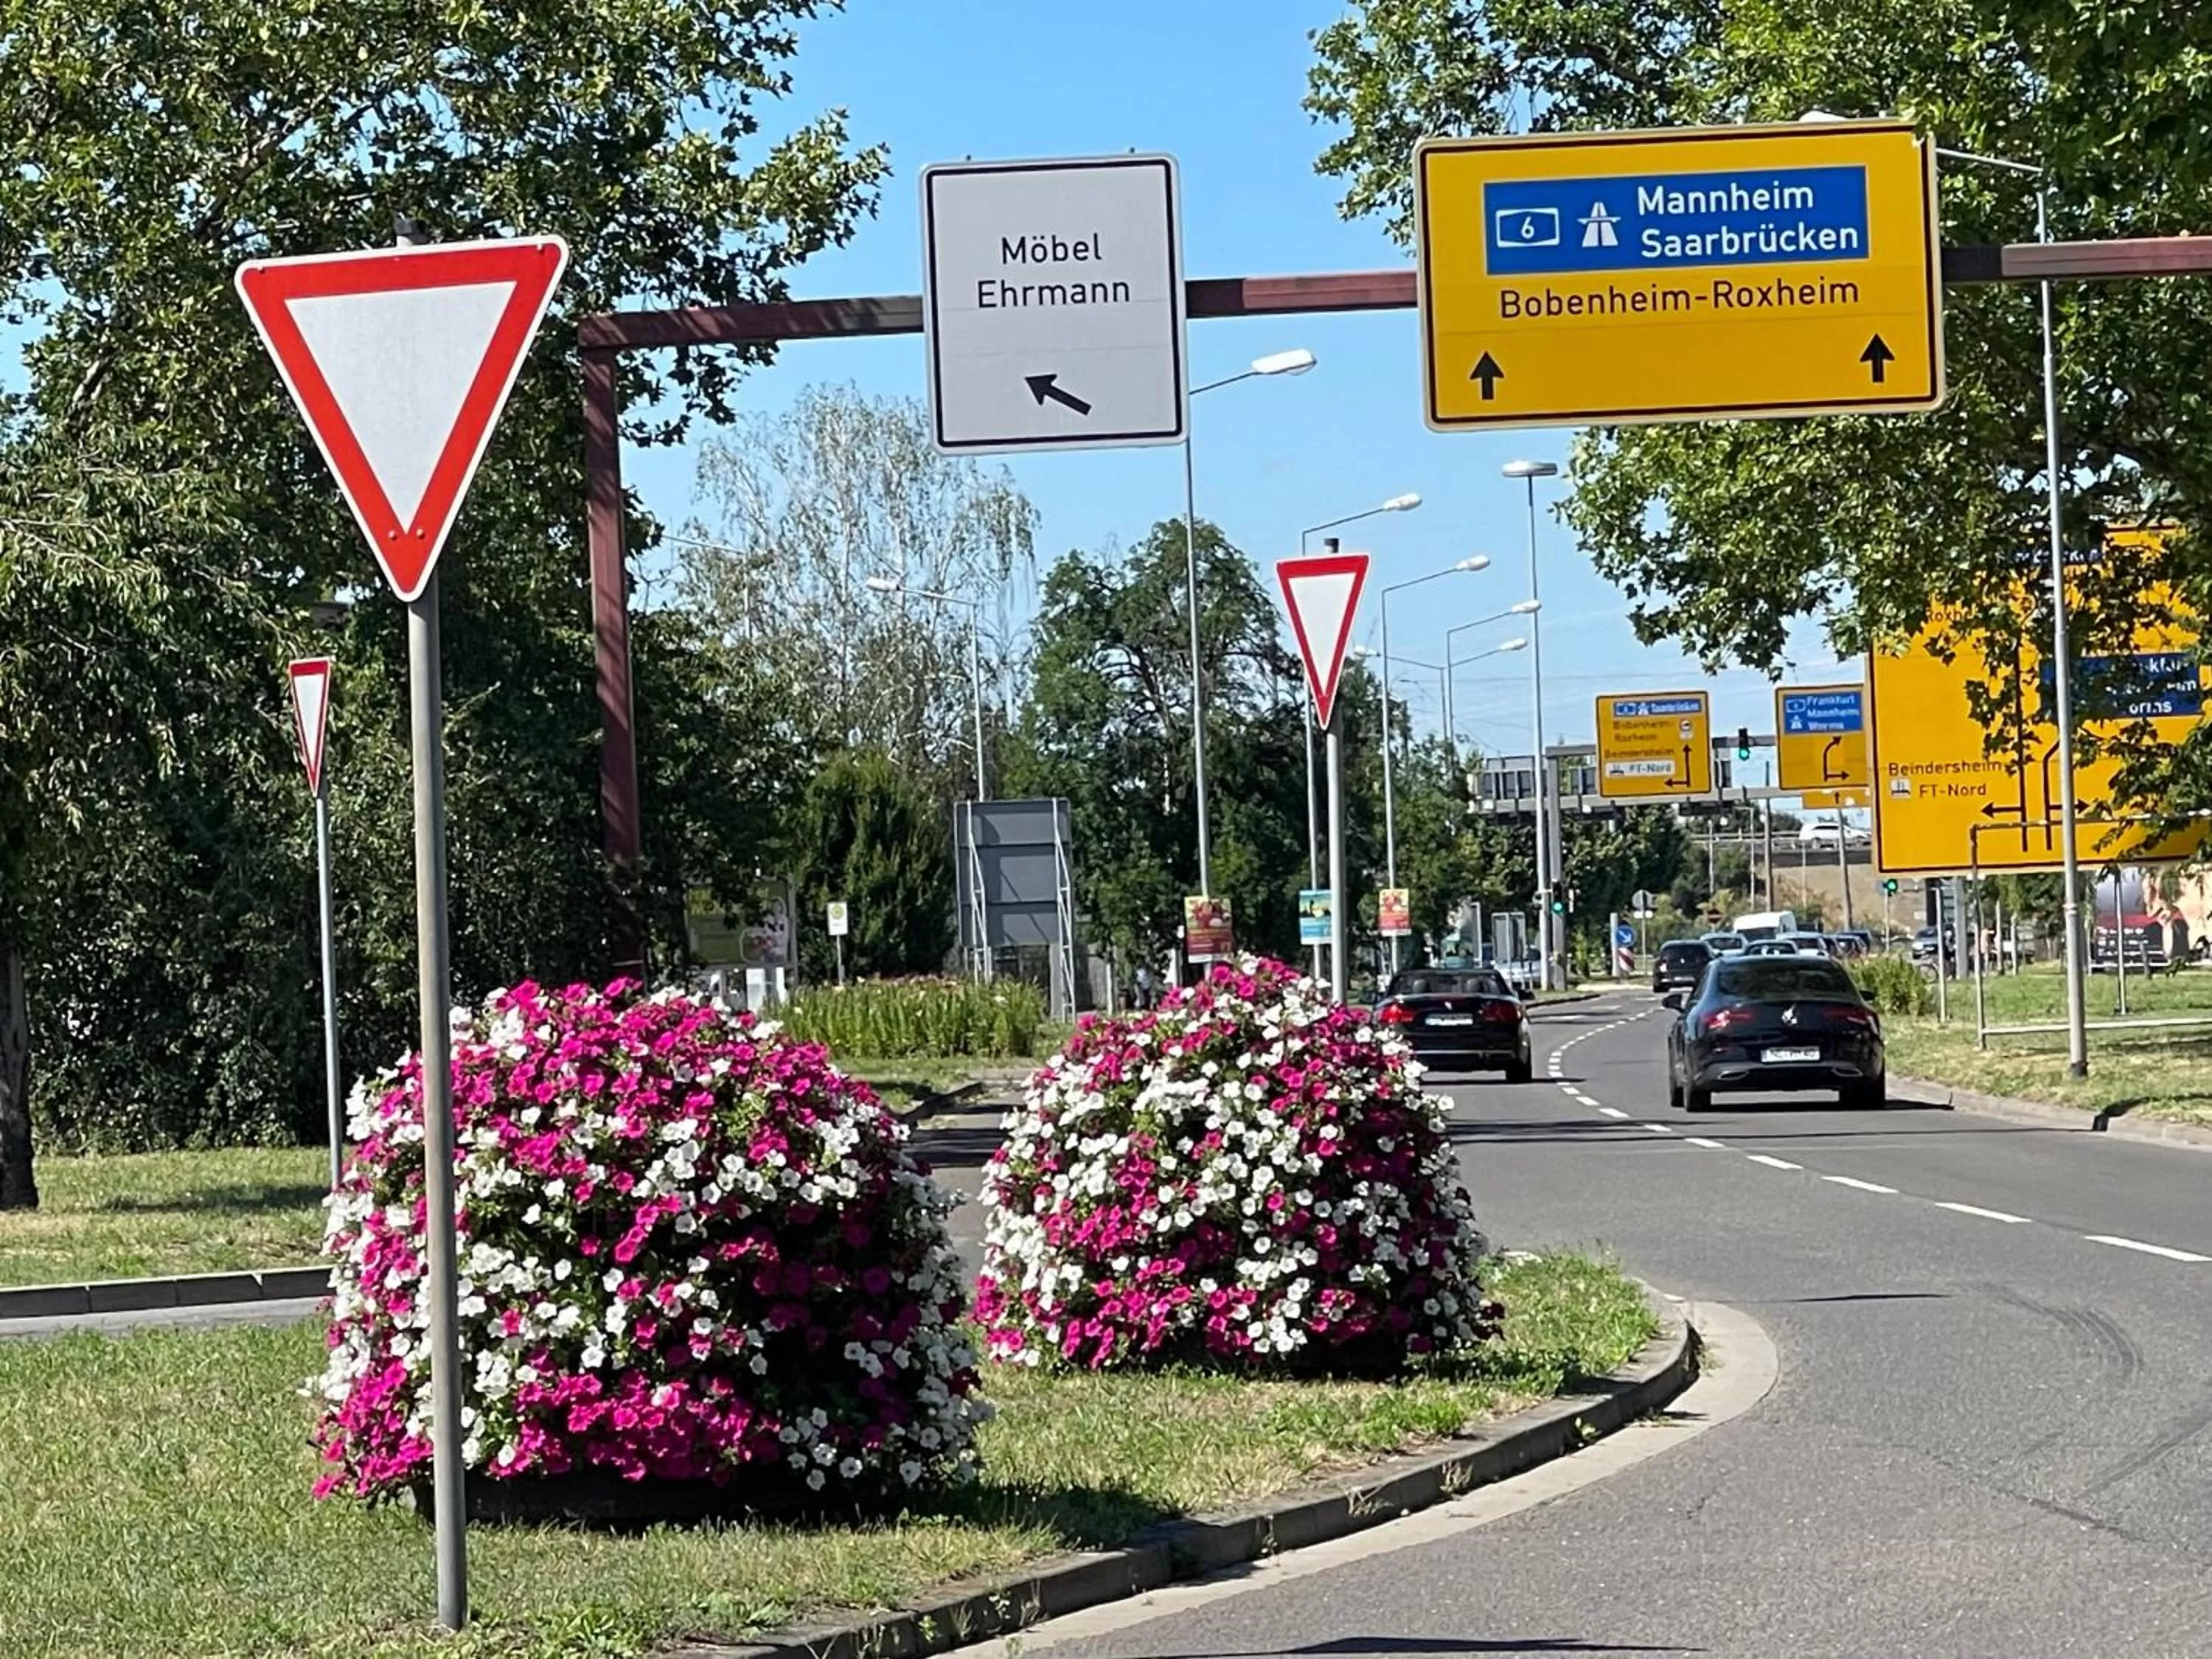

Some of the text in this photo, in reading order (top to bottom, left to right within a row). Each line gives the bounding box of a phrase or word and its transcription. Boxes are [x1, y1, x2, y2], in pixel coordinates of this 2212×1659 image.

[1637, 181, 1814, 215] Mannheim
[1520, 216, 1535, 240] 6
[1641, 221, 1859, 259] Saarbrücken
[1001, 232, 1102, 264] Möbel
[978, 279, 1130, 309] Ehrmann
[1500, 276, 1860, 319] Bobenheim-Roxheim
[1888, 759, 2002, 776] Beindersheim
[1919, 782, 1986, 799] FT-Nord
